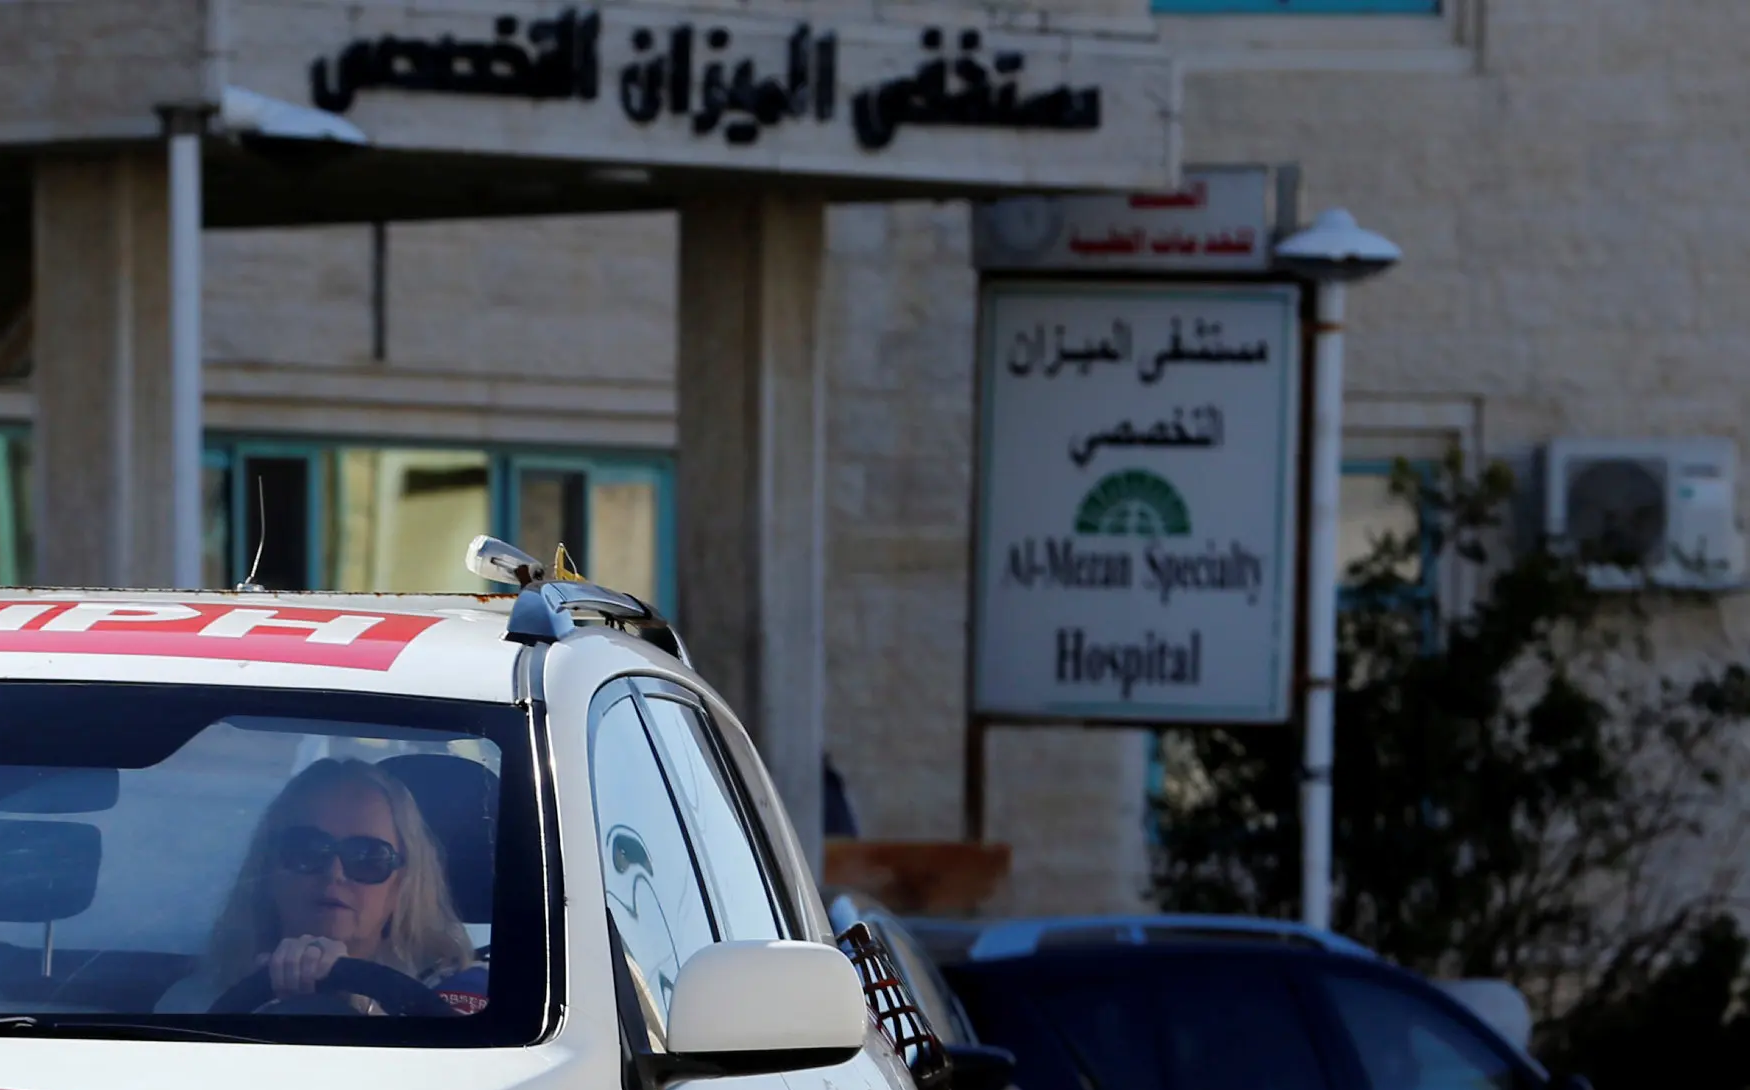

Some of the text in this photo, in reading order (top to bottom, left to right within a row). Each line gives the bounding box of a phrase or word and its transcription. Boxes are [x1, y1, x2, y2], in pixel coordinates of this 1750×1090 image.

[621, 23, 837, 145] الميزان
[1007, 317, 1134, 377] الميزان
[1142, 537, 1262, 606] Specialty
[1055, 626, 1201, 699] Hospital
